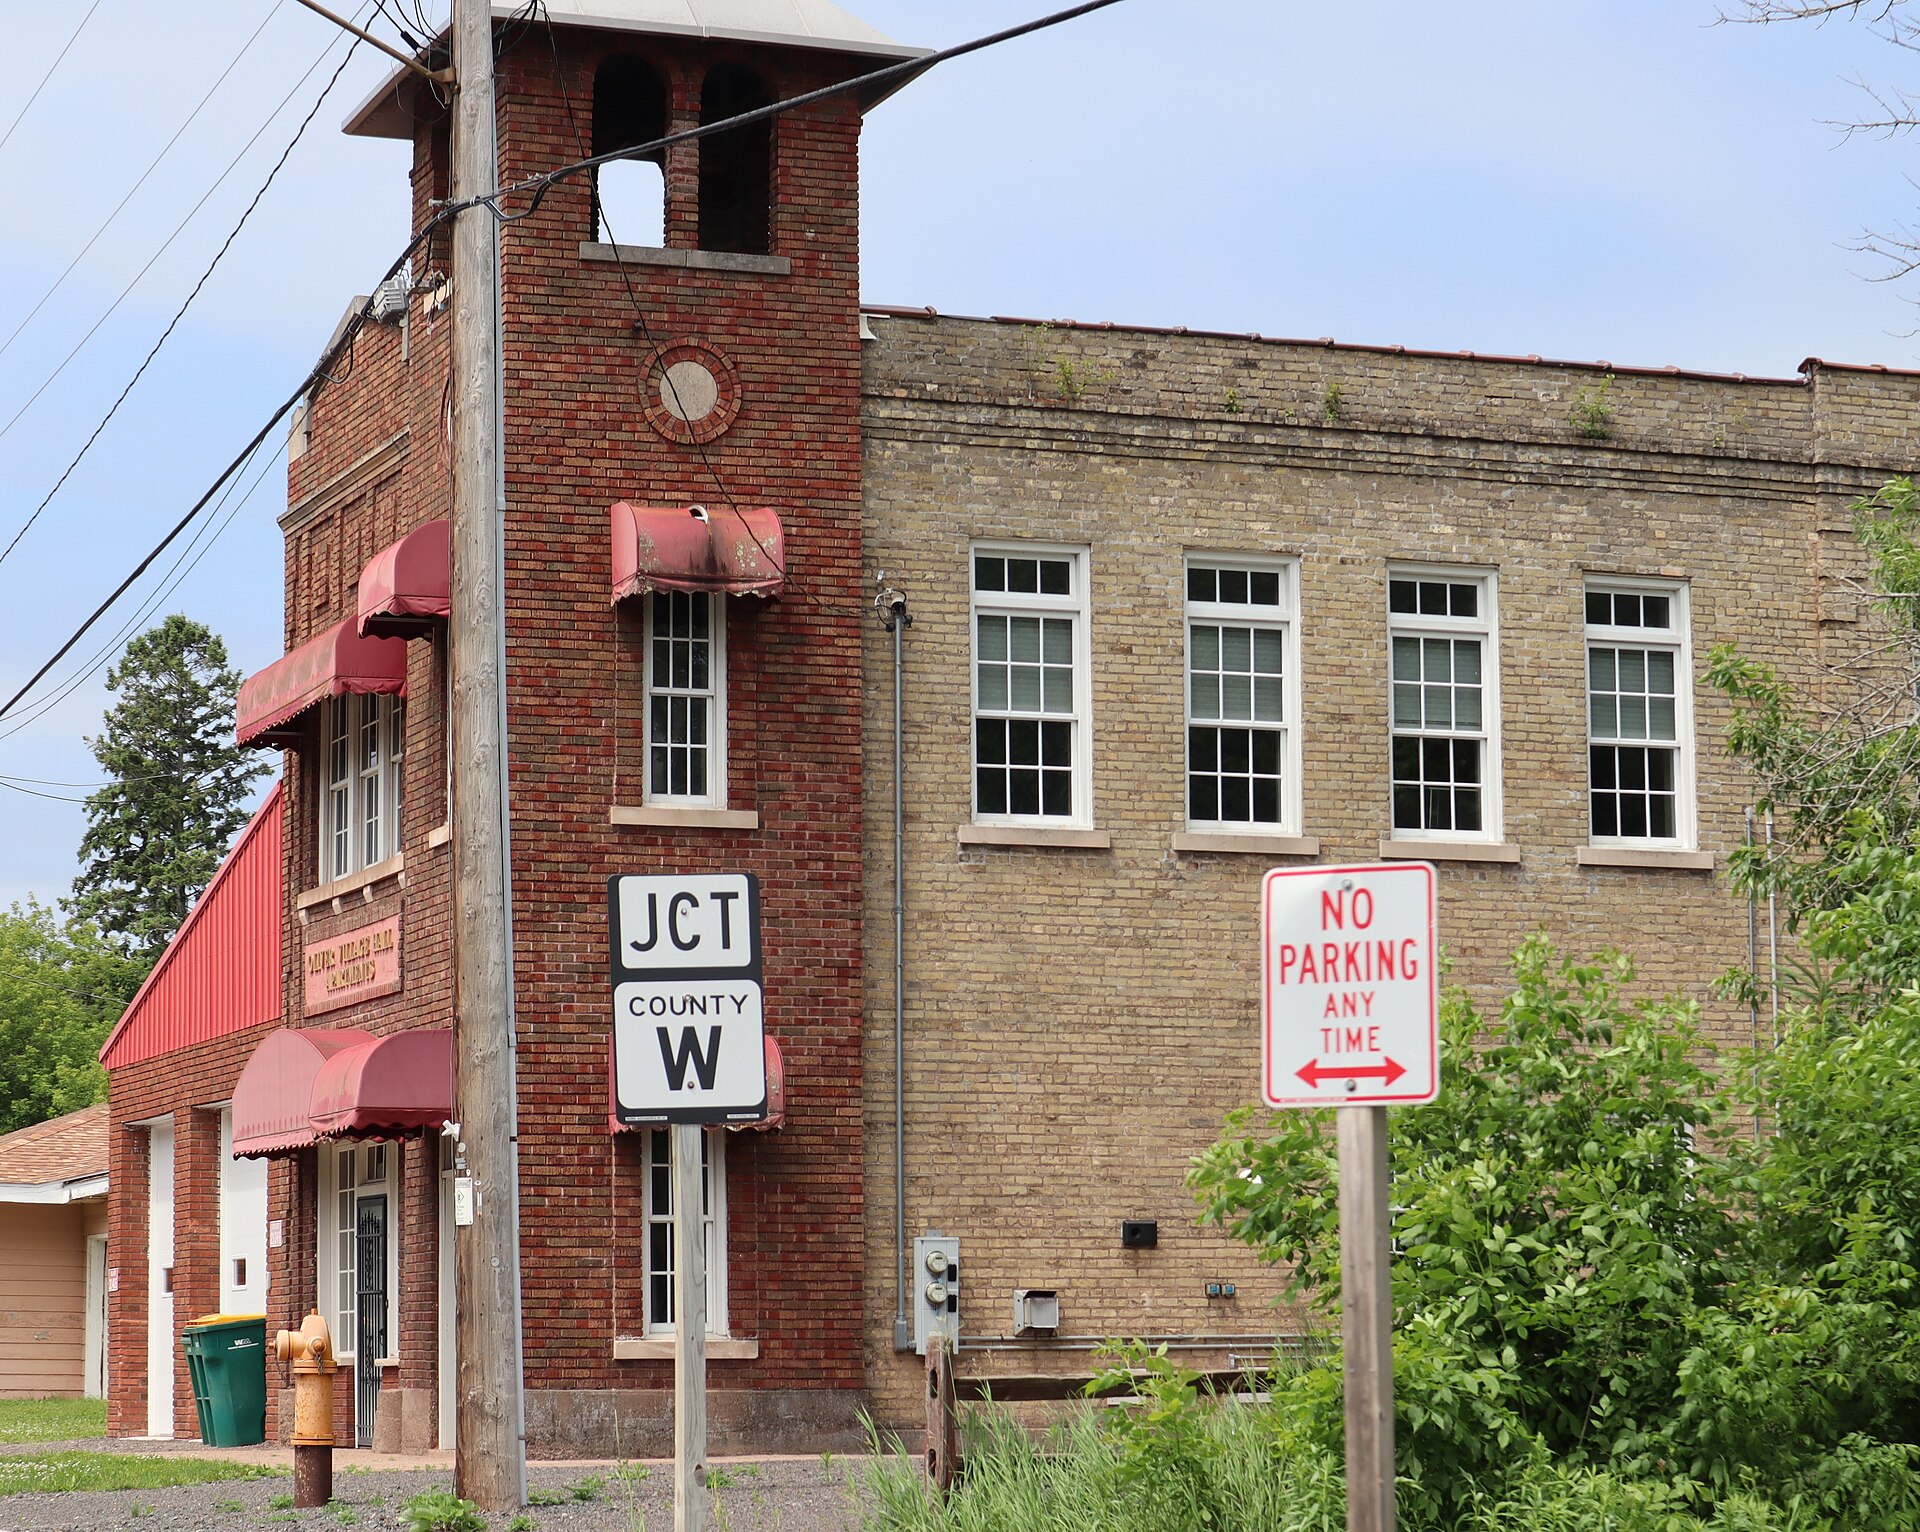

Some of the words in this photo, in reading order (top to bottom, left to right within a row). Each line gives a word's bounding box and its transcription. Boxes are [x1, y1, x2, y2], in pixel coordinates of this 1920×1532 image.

[629, 891, 739, 952] JCT
[1321, 888, 1373, 931] NO
[1280, 938, 1418, 984] PARKING
[629, 994, 748, 1016] COUNTY
[1323, 991, 1376, 1018] ANY
[655, 1026, 723, 1091] W
[1320, 1026, 1381, 1053] TIME
